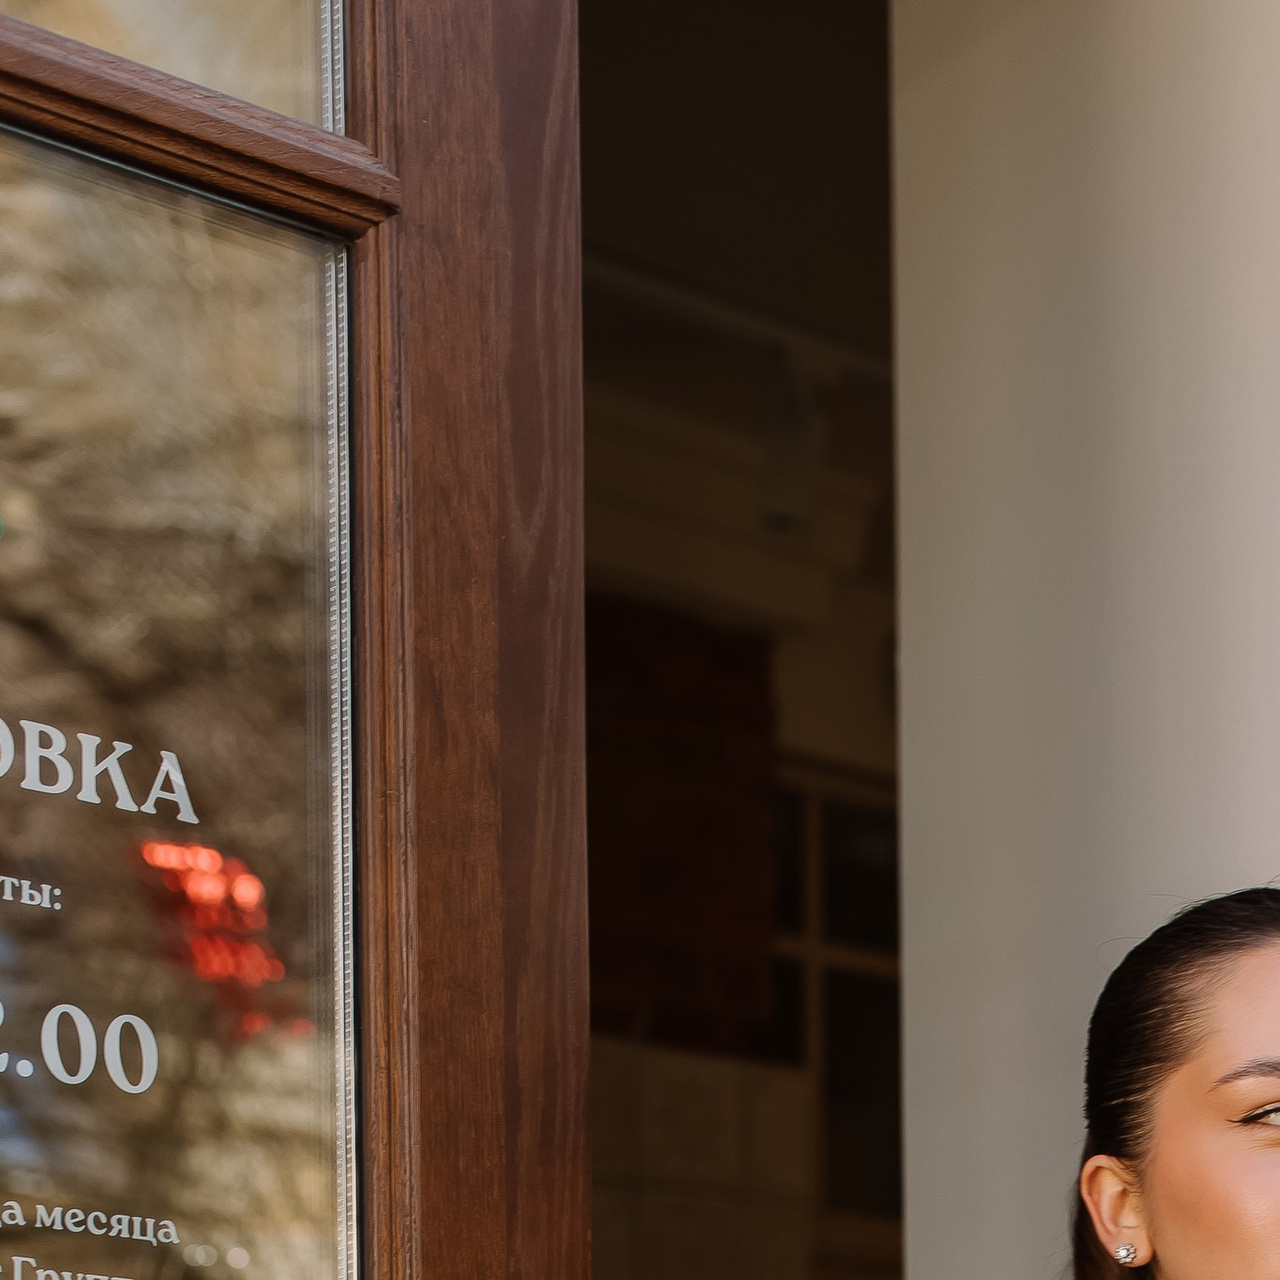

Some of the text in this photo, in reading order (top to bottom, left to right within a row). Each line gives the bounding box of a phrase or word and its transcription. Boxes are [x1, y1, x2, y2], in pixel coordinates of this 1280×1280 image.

[0, 717, 199, 824] ВКА
[0, 1001, 158, 1093] .00
[0, 1201, 180, 1246] а месяца
